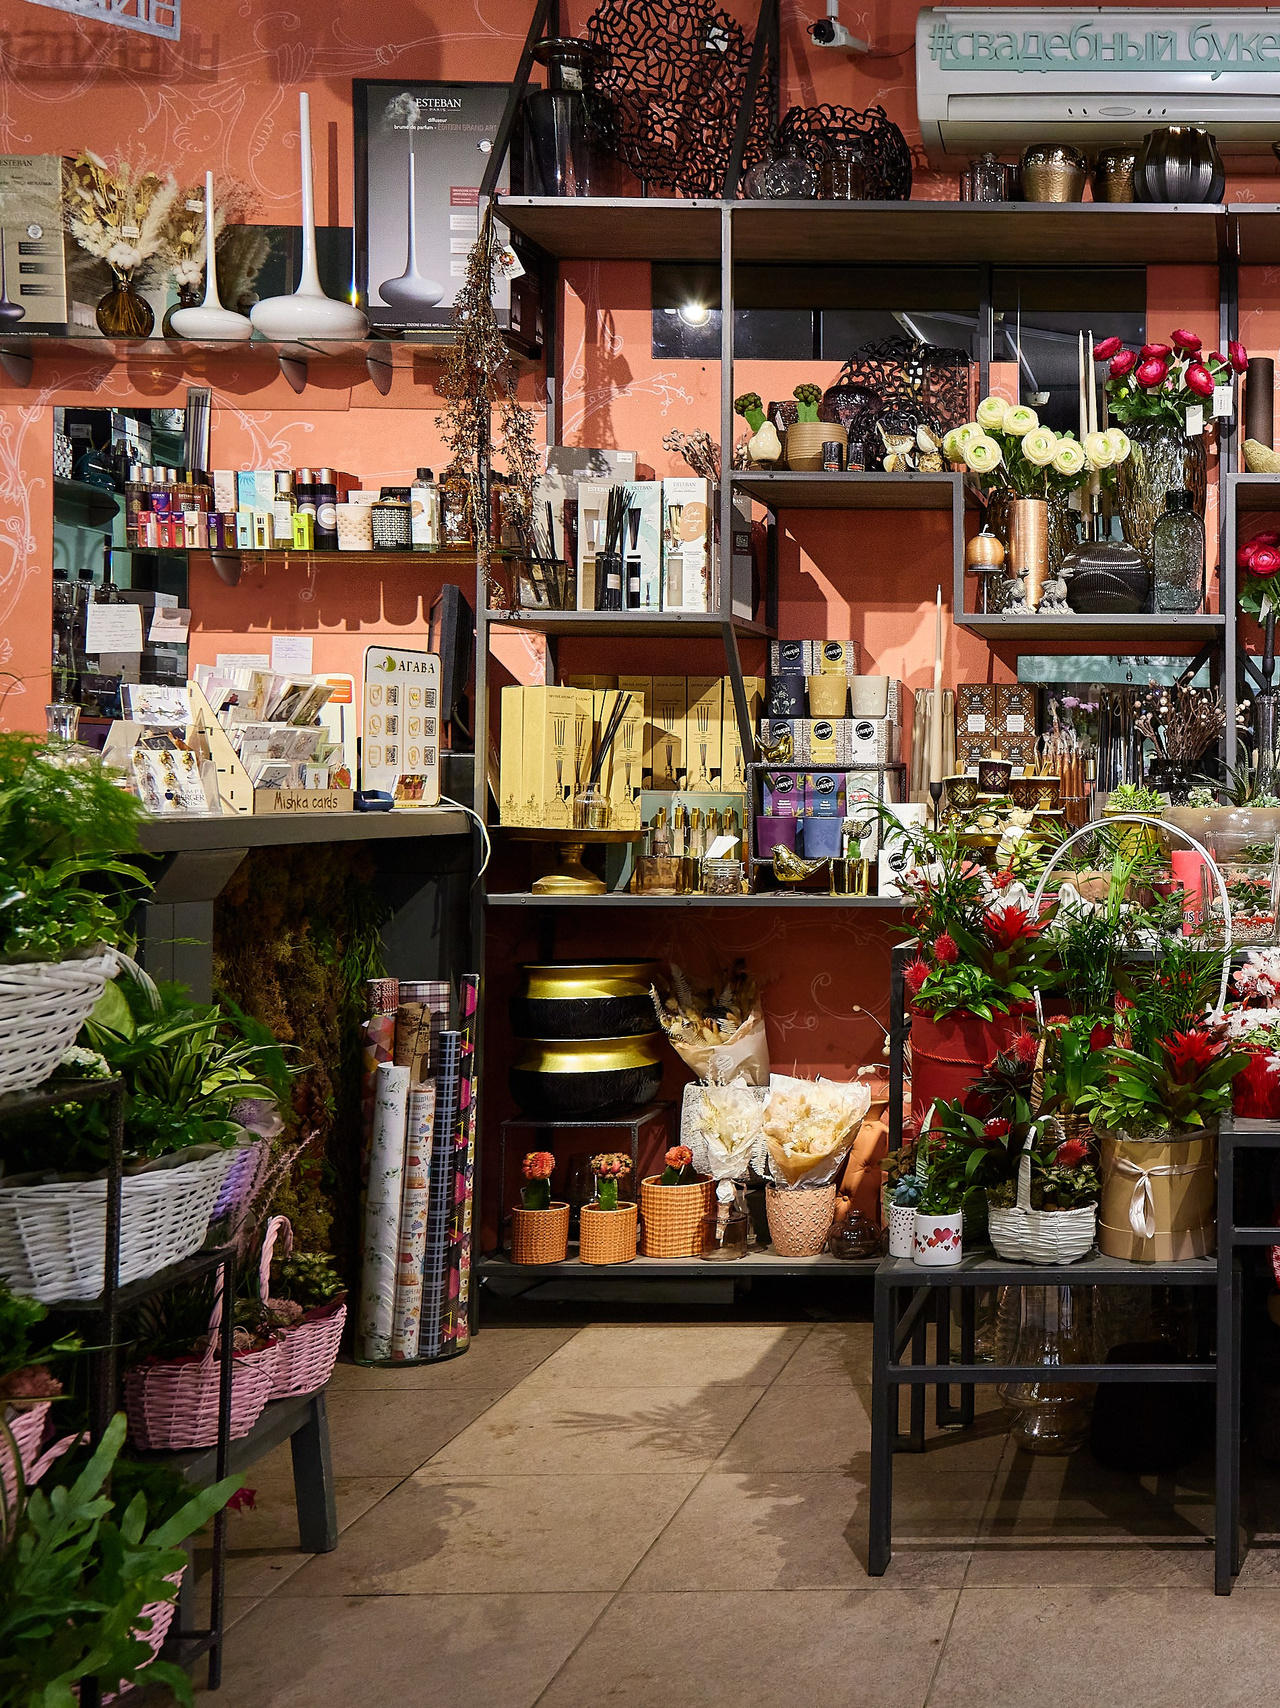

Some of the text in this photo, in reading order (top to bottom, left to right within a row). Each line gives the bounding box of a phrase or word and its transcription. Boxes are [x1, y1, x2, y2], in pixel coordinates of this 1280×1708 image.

[928, 20, 1179, 73] #свадебный
[416, 98, 462, 108] ESTEBAN
[398, 660, 436, 675] АГАВА
[273, 791, 338, 812] Mishka cards
